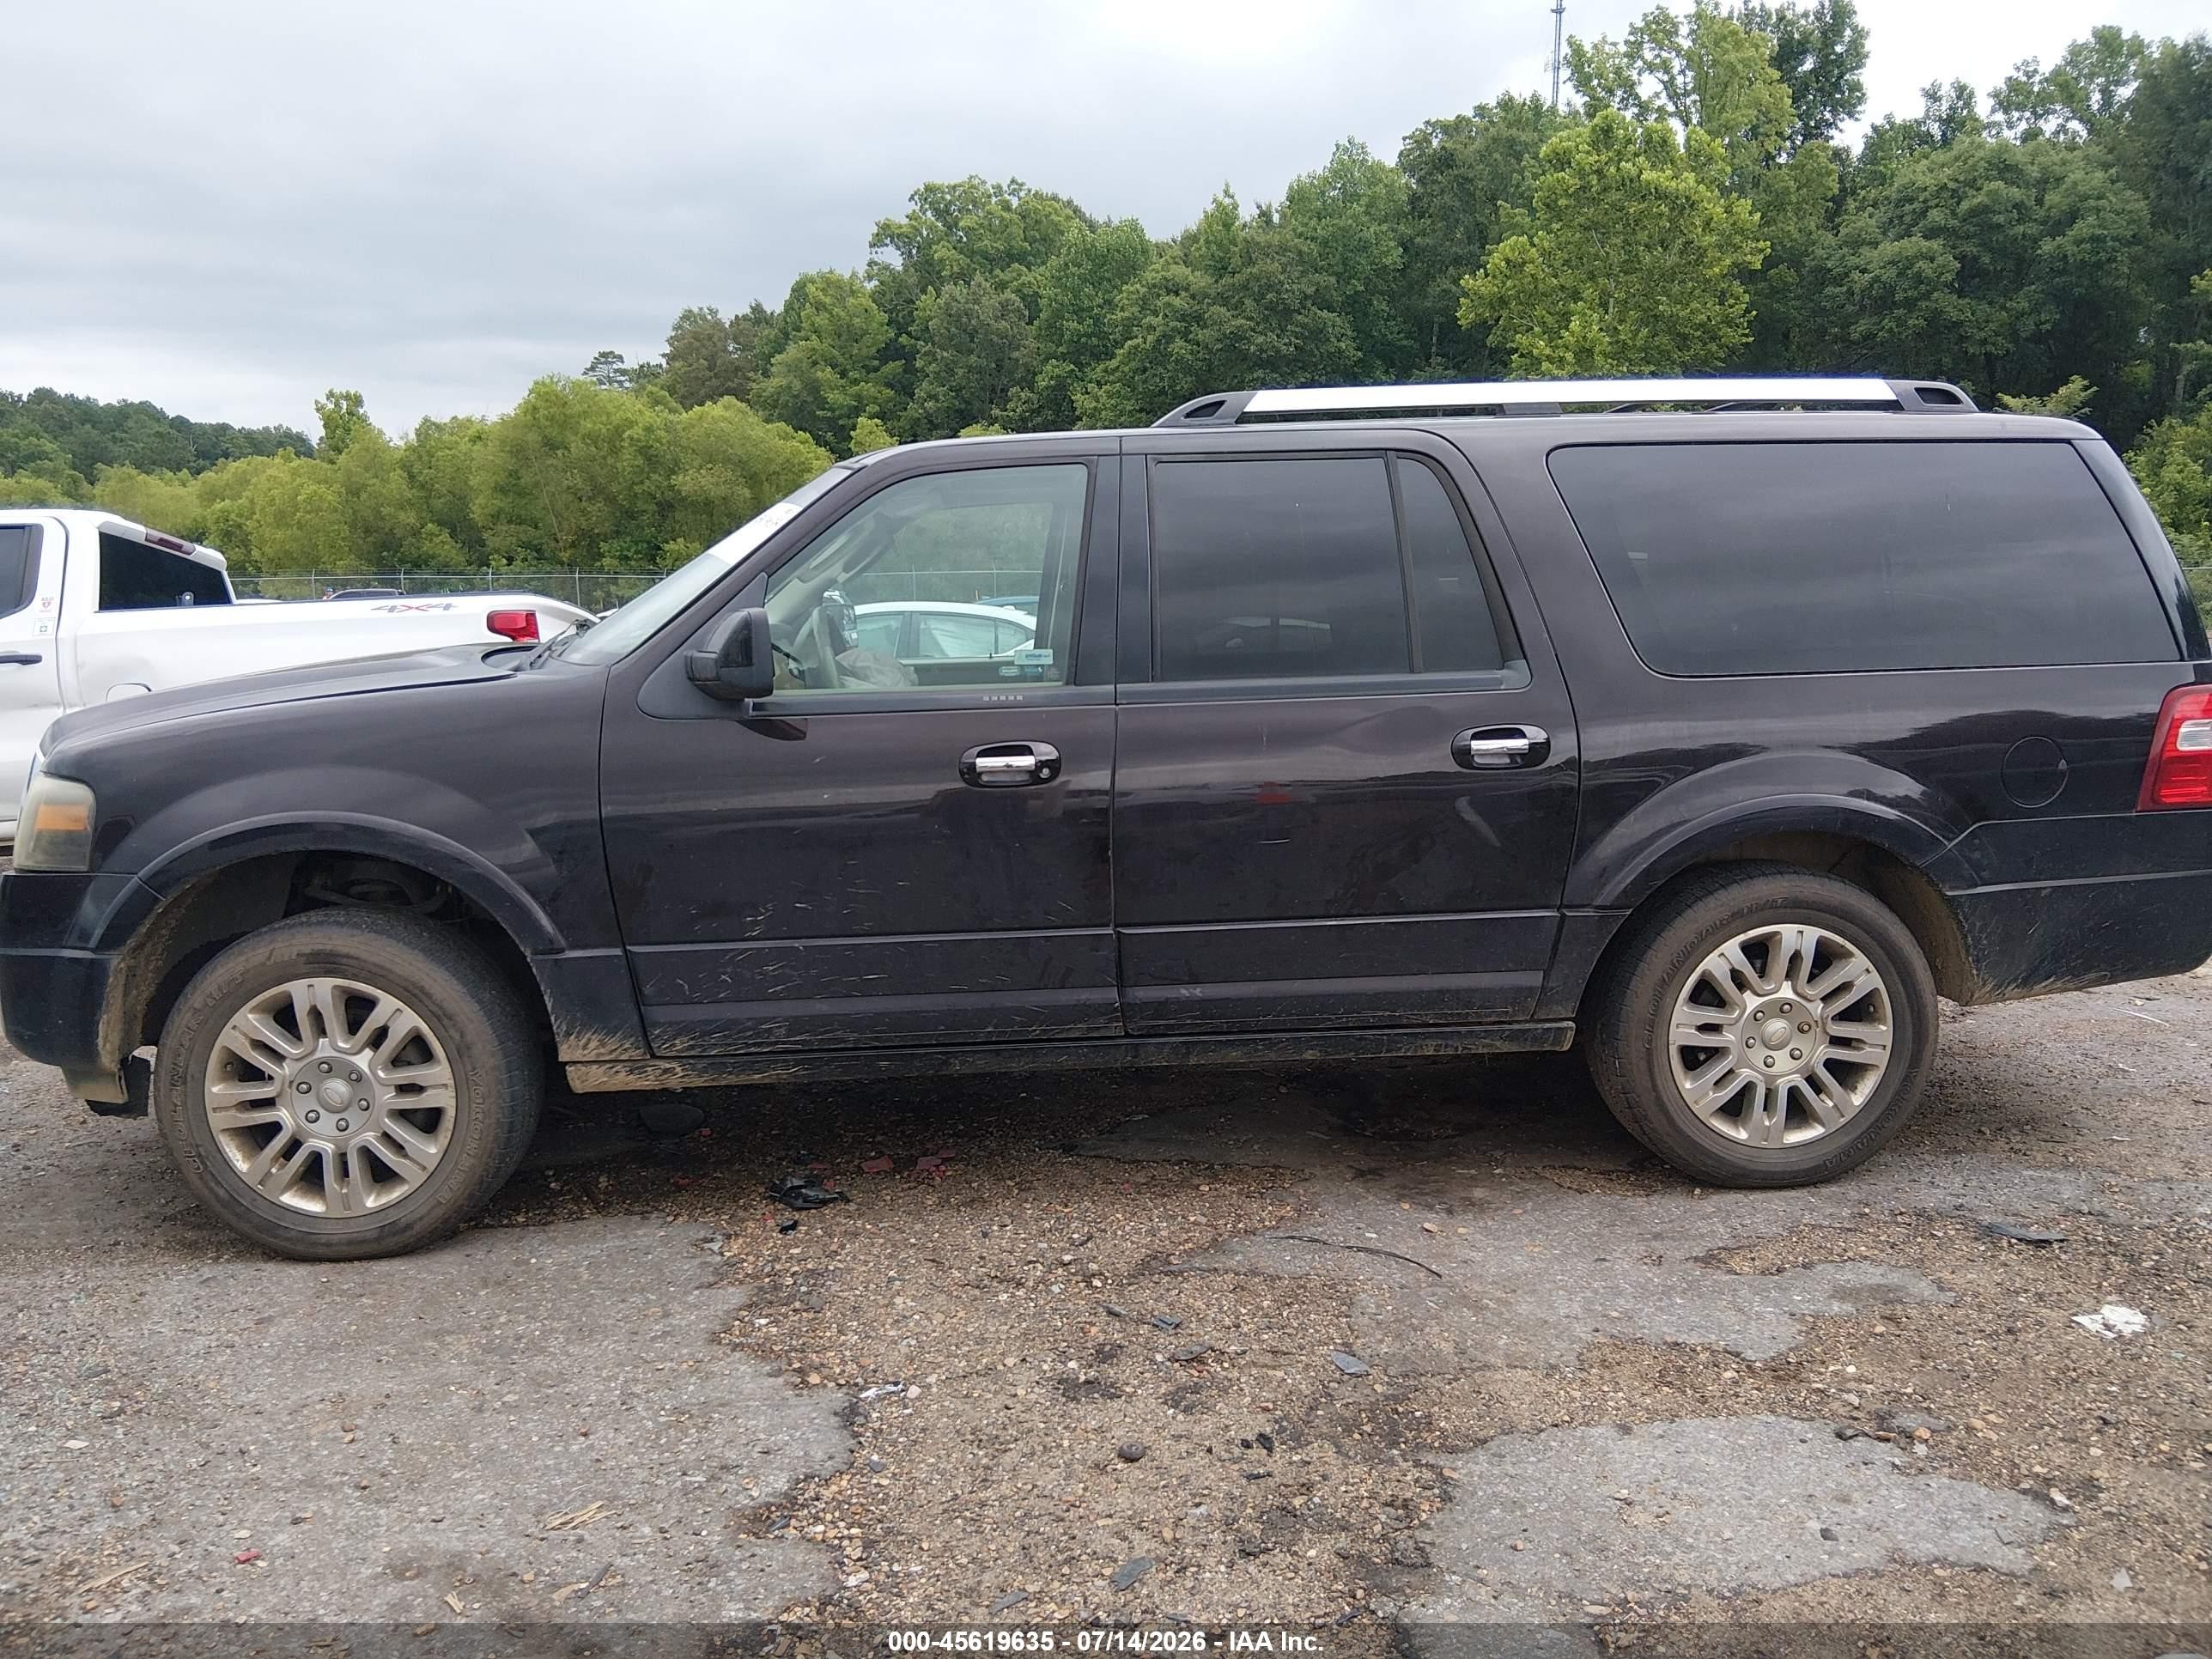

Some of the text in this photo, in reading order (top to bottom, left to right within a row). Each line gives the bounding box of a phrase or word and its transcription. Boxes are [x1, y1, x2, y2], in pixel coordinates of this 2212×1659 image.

[1642, 912, 1732, 1050] GEOLANDAR
[169, 1012, 206, 1174] GEOLANDAR
[435, 1070, 486, 1205] YOKOHAMA
[1822, 1067, 1920, 1170] YOKOHAMA
